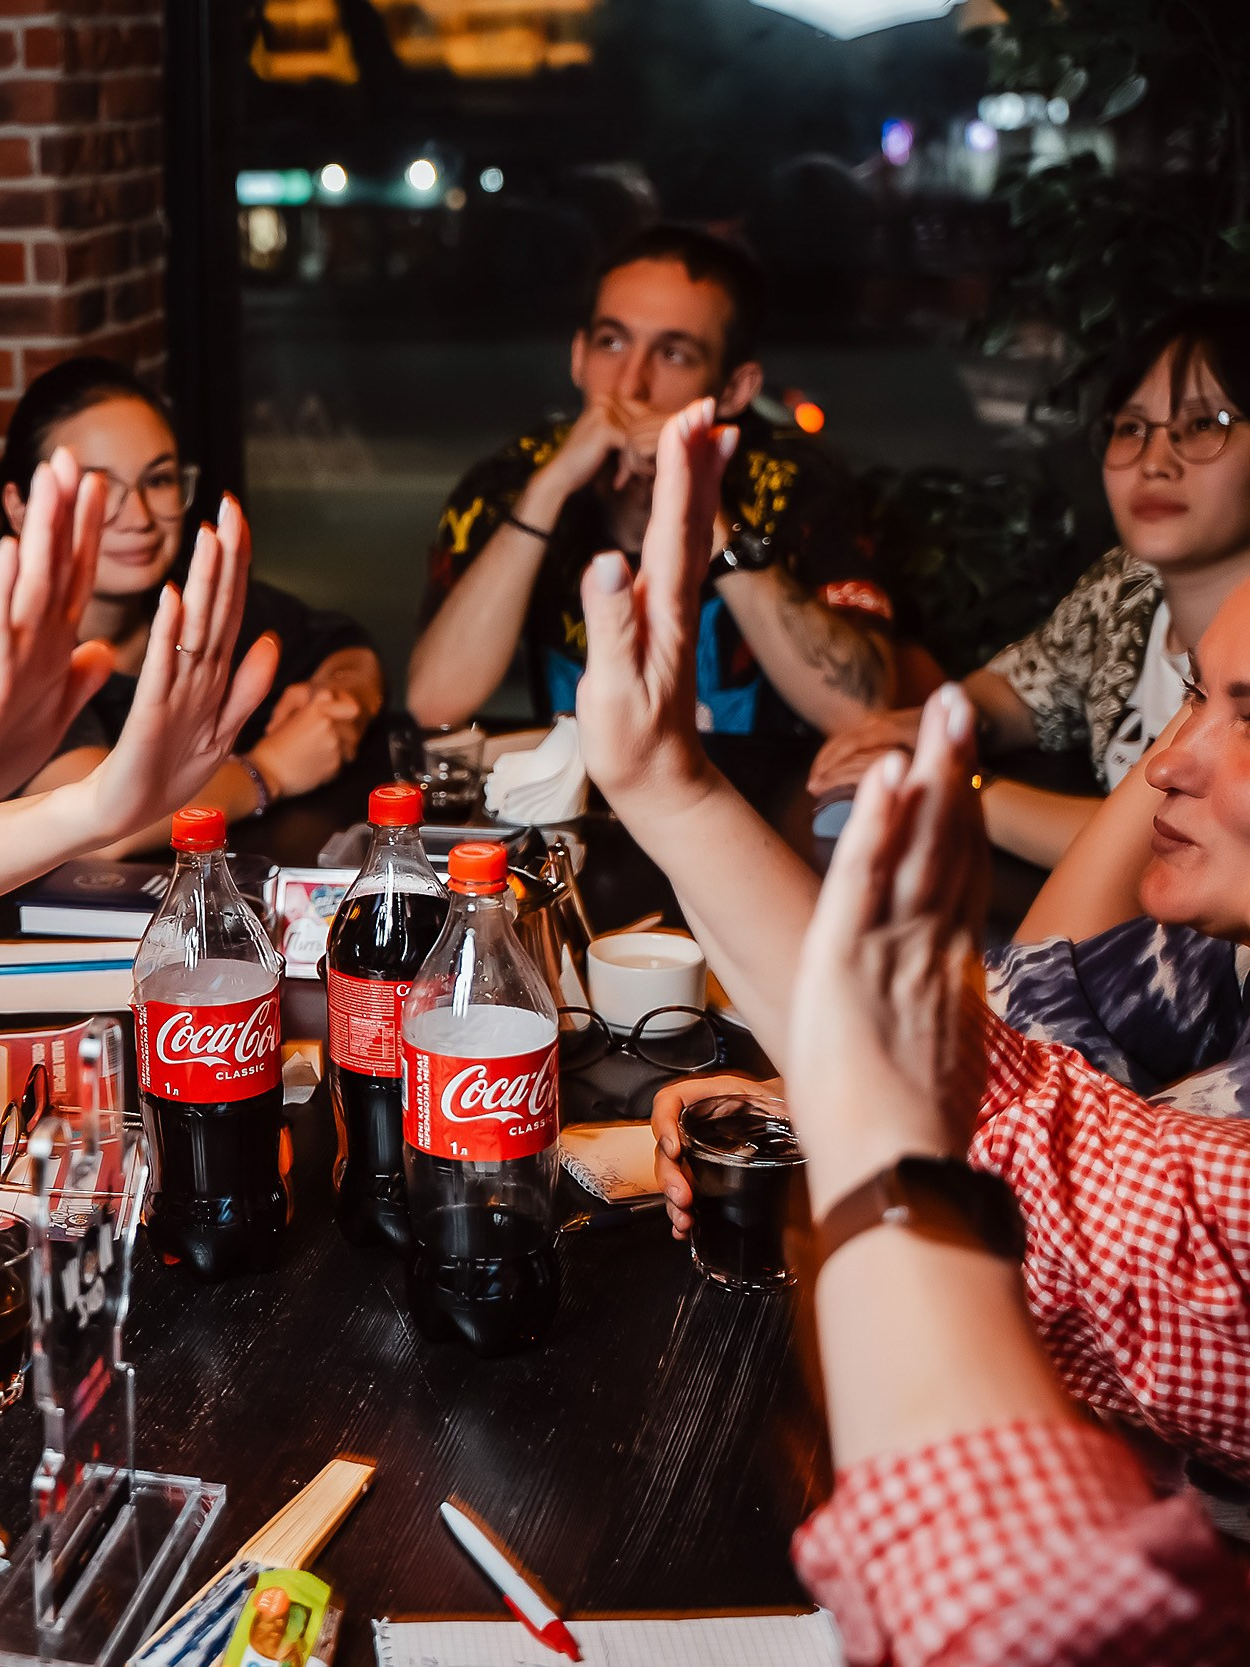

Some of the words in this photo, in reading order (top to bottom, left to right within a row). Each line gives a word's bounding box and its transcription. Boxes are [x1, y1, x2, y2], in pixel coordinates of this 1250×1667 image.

[215, 1062, 265, 1081] CLASSIC
[422, 1055, 430, 1081] МЕНЯ
[422, 1083, 431, 1149] ПЕРЕРАБОТАЙ
[508, 1114, 553, 1136] CLASSIC
